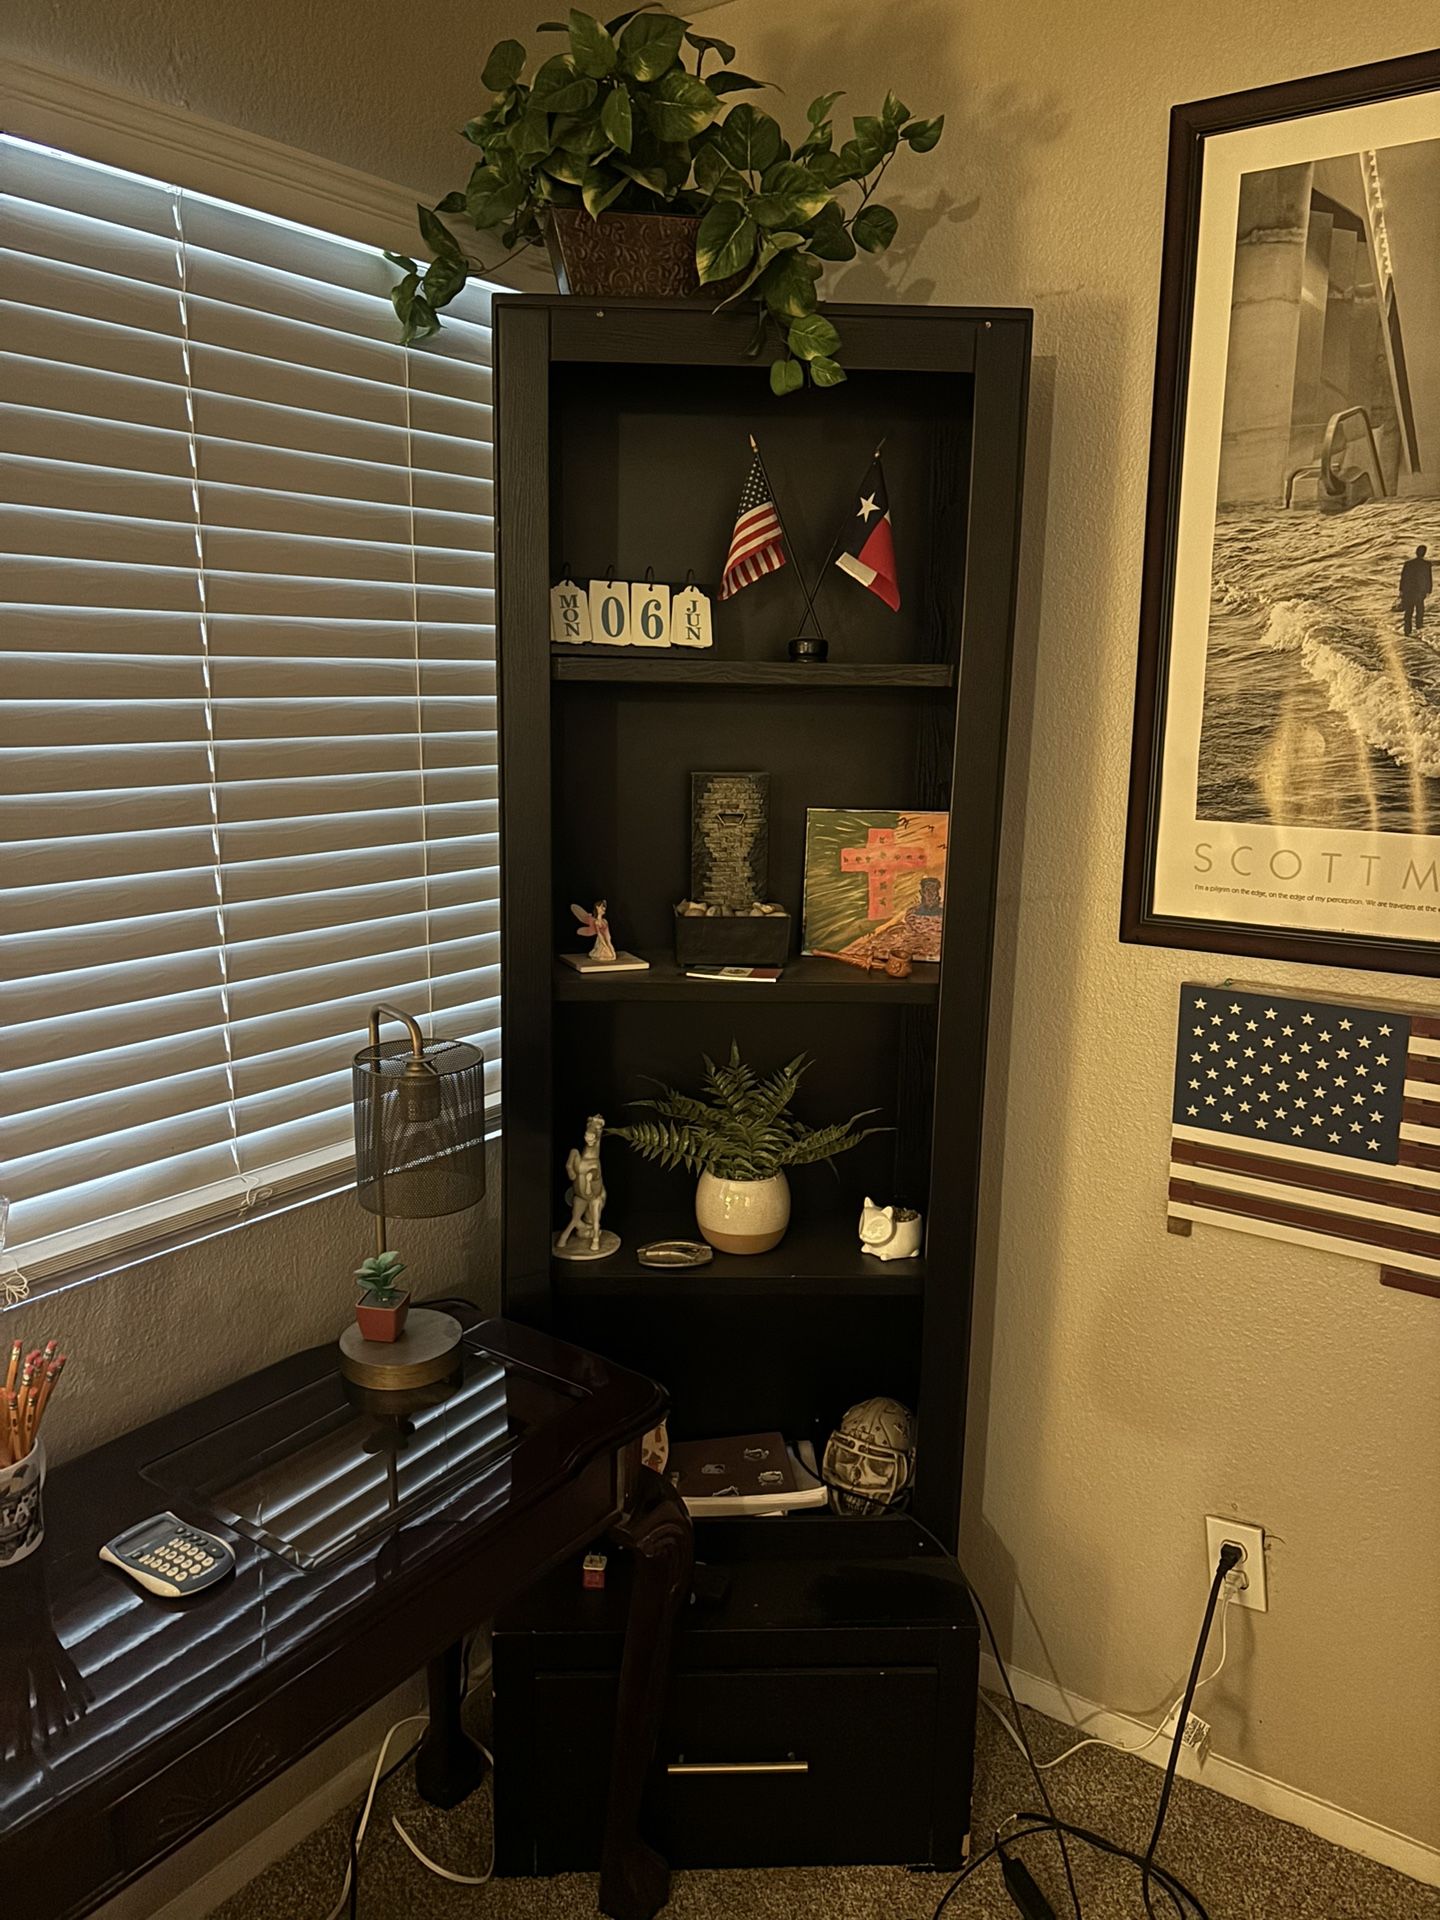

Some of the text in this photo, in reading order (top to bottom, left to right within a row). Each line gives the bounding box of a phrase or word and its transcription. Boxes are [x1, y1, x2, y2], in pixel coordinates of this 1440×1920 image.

[559, 594, 580, 637] MON
[686, 600, 701, 641] JUN
[1194, 843, 1381, 886] SCOTT
[1210, 886, 1230, 894] pilgrim
[1251, 889, 1267, 898] edge,
[1278, 892, 1288, 900] the
[1289, 894, 1306, 902] edge
[1326, 896, 1364, 905] perception.
[1389, 902, 1415, 911] travelers
[1425, 905, 1437, 913] the
